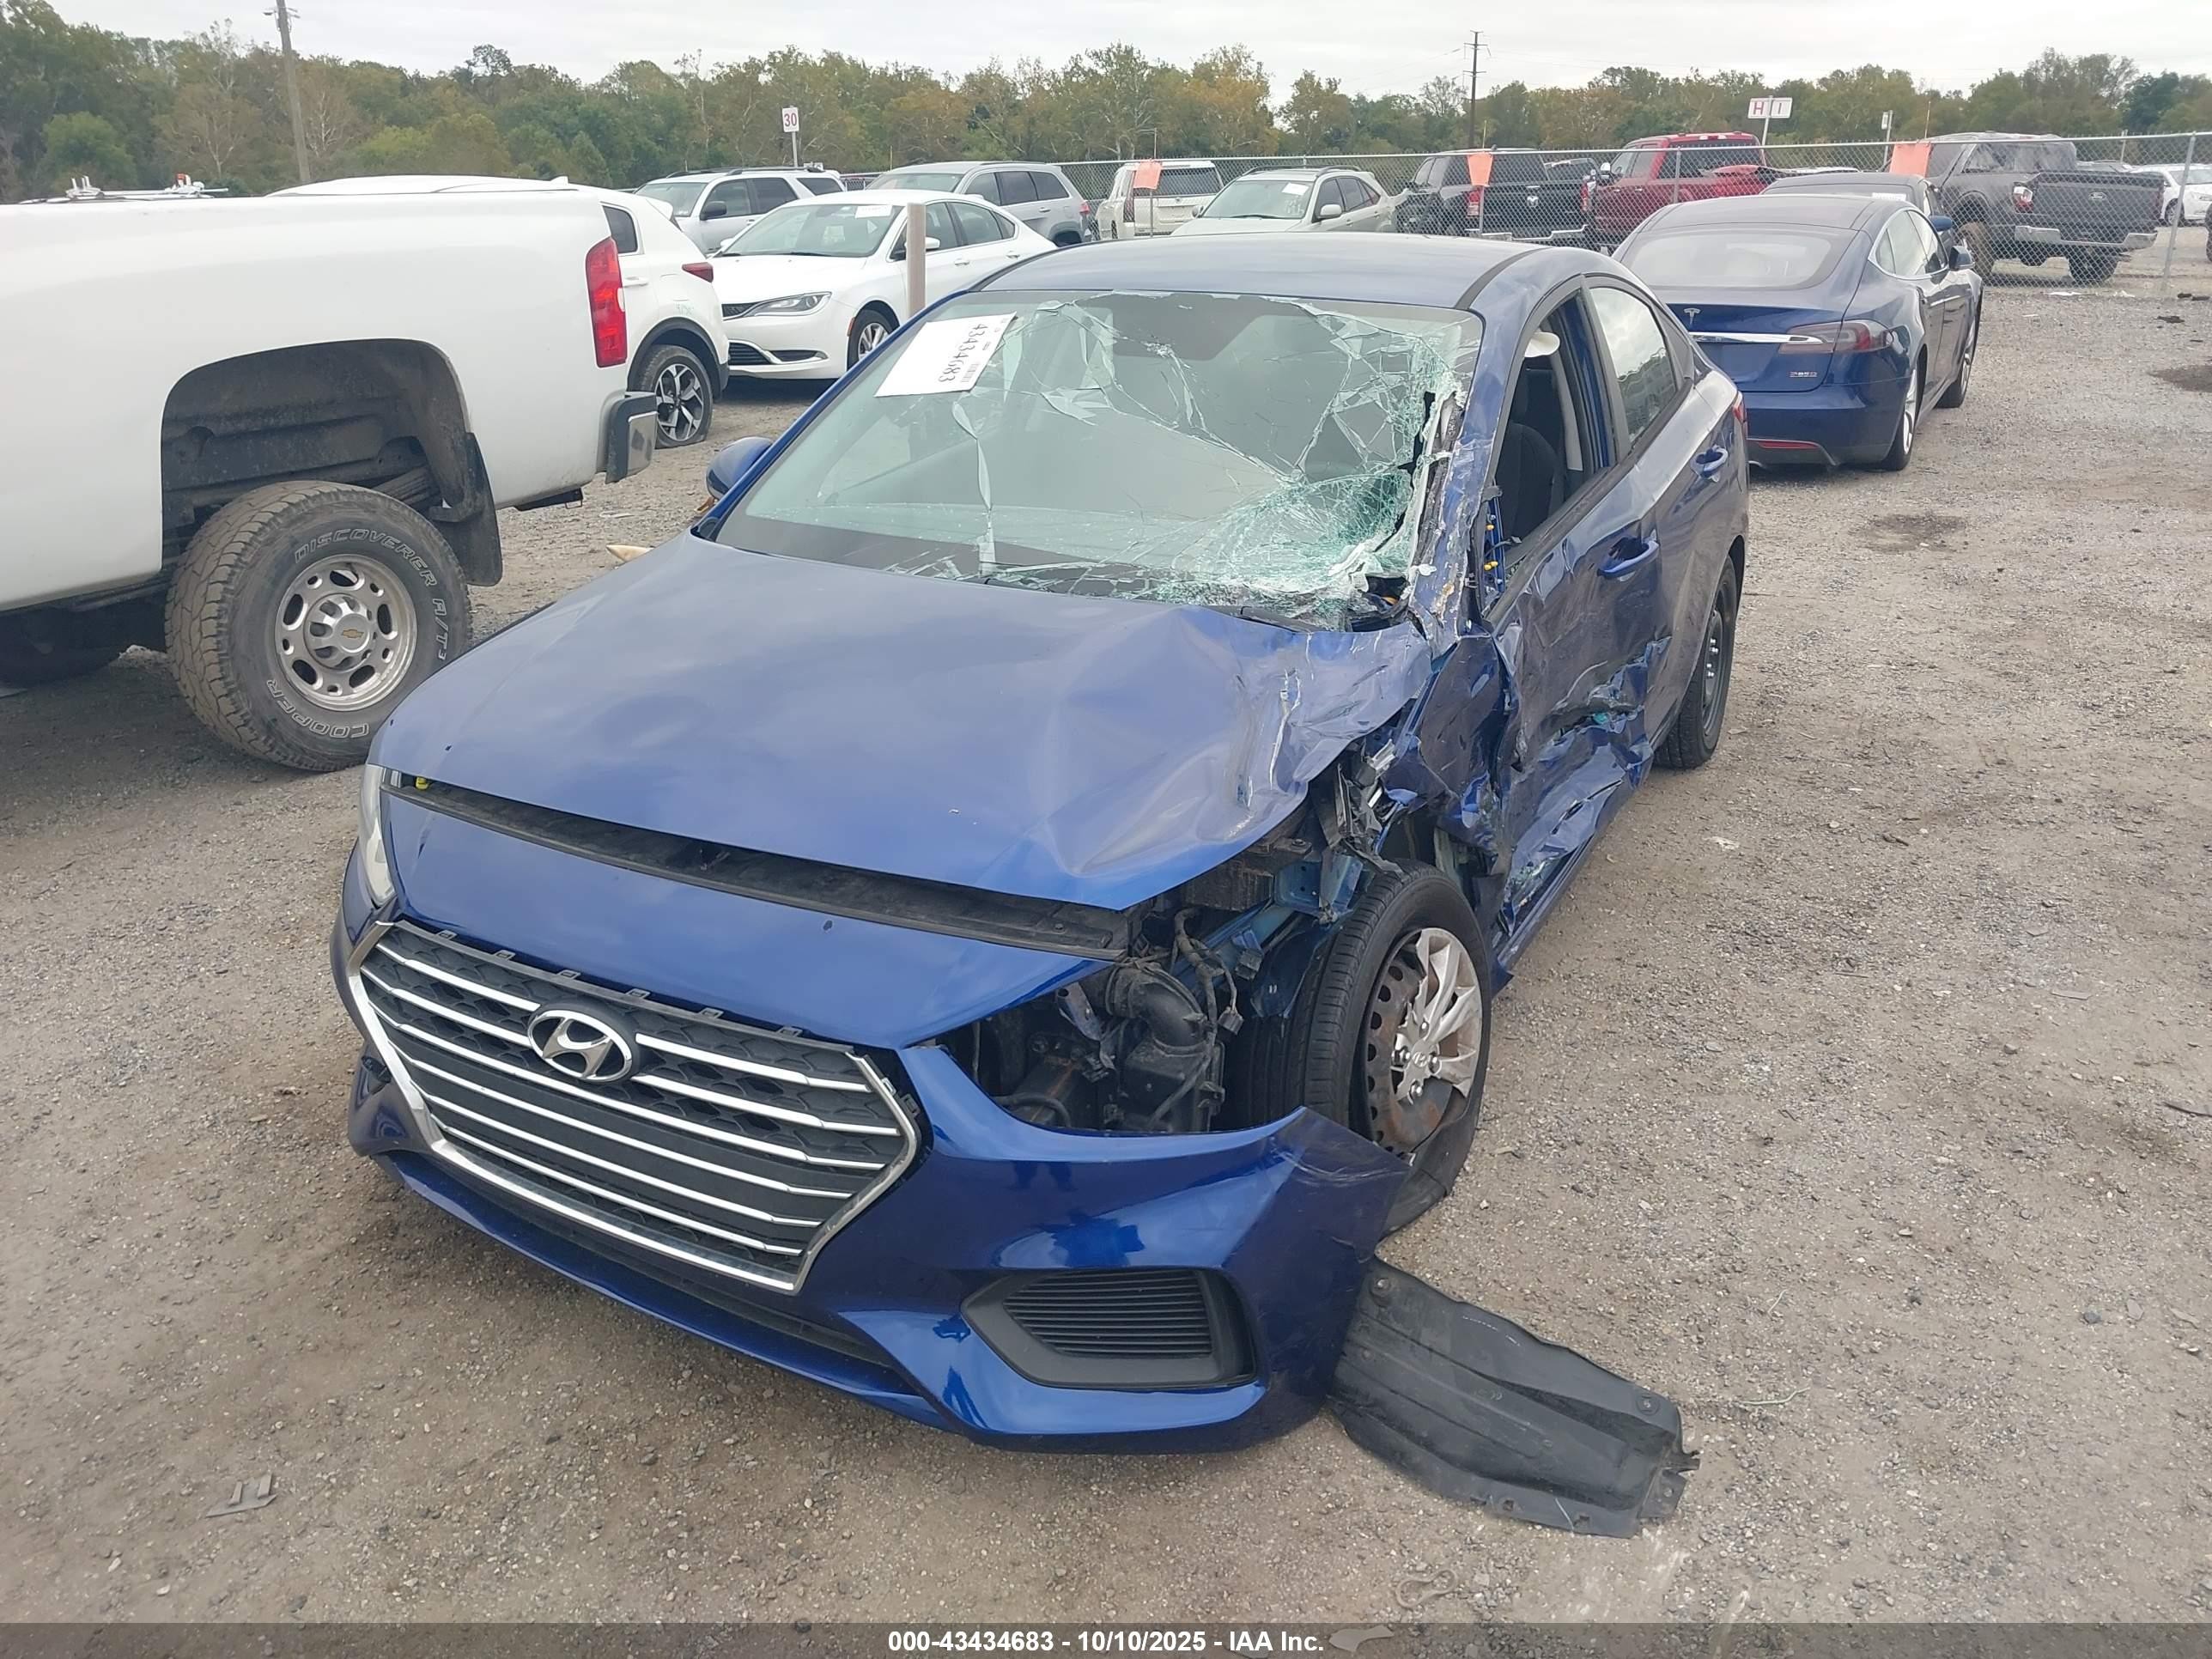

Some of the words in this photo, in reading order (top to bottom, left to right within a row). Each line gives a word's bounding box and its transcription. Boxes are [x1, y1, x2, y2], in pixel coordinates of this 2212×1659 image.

[784, 112, 797, 127] 30
[1753, 101, 1765, 116] H
[938, 323, 988, 383] 43434683
[295, 528, 438, 586] DISCOVERER
[266, 679, 369, 738] COOPER
